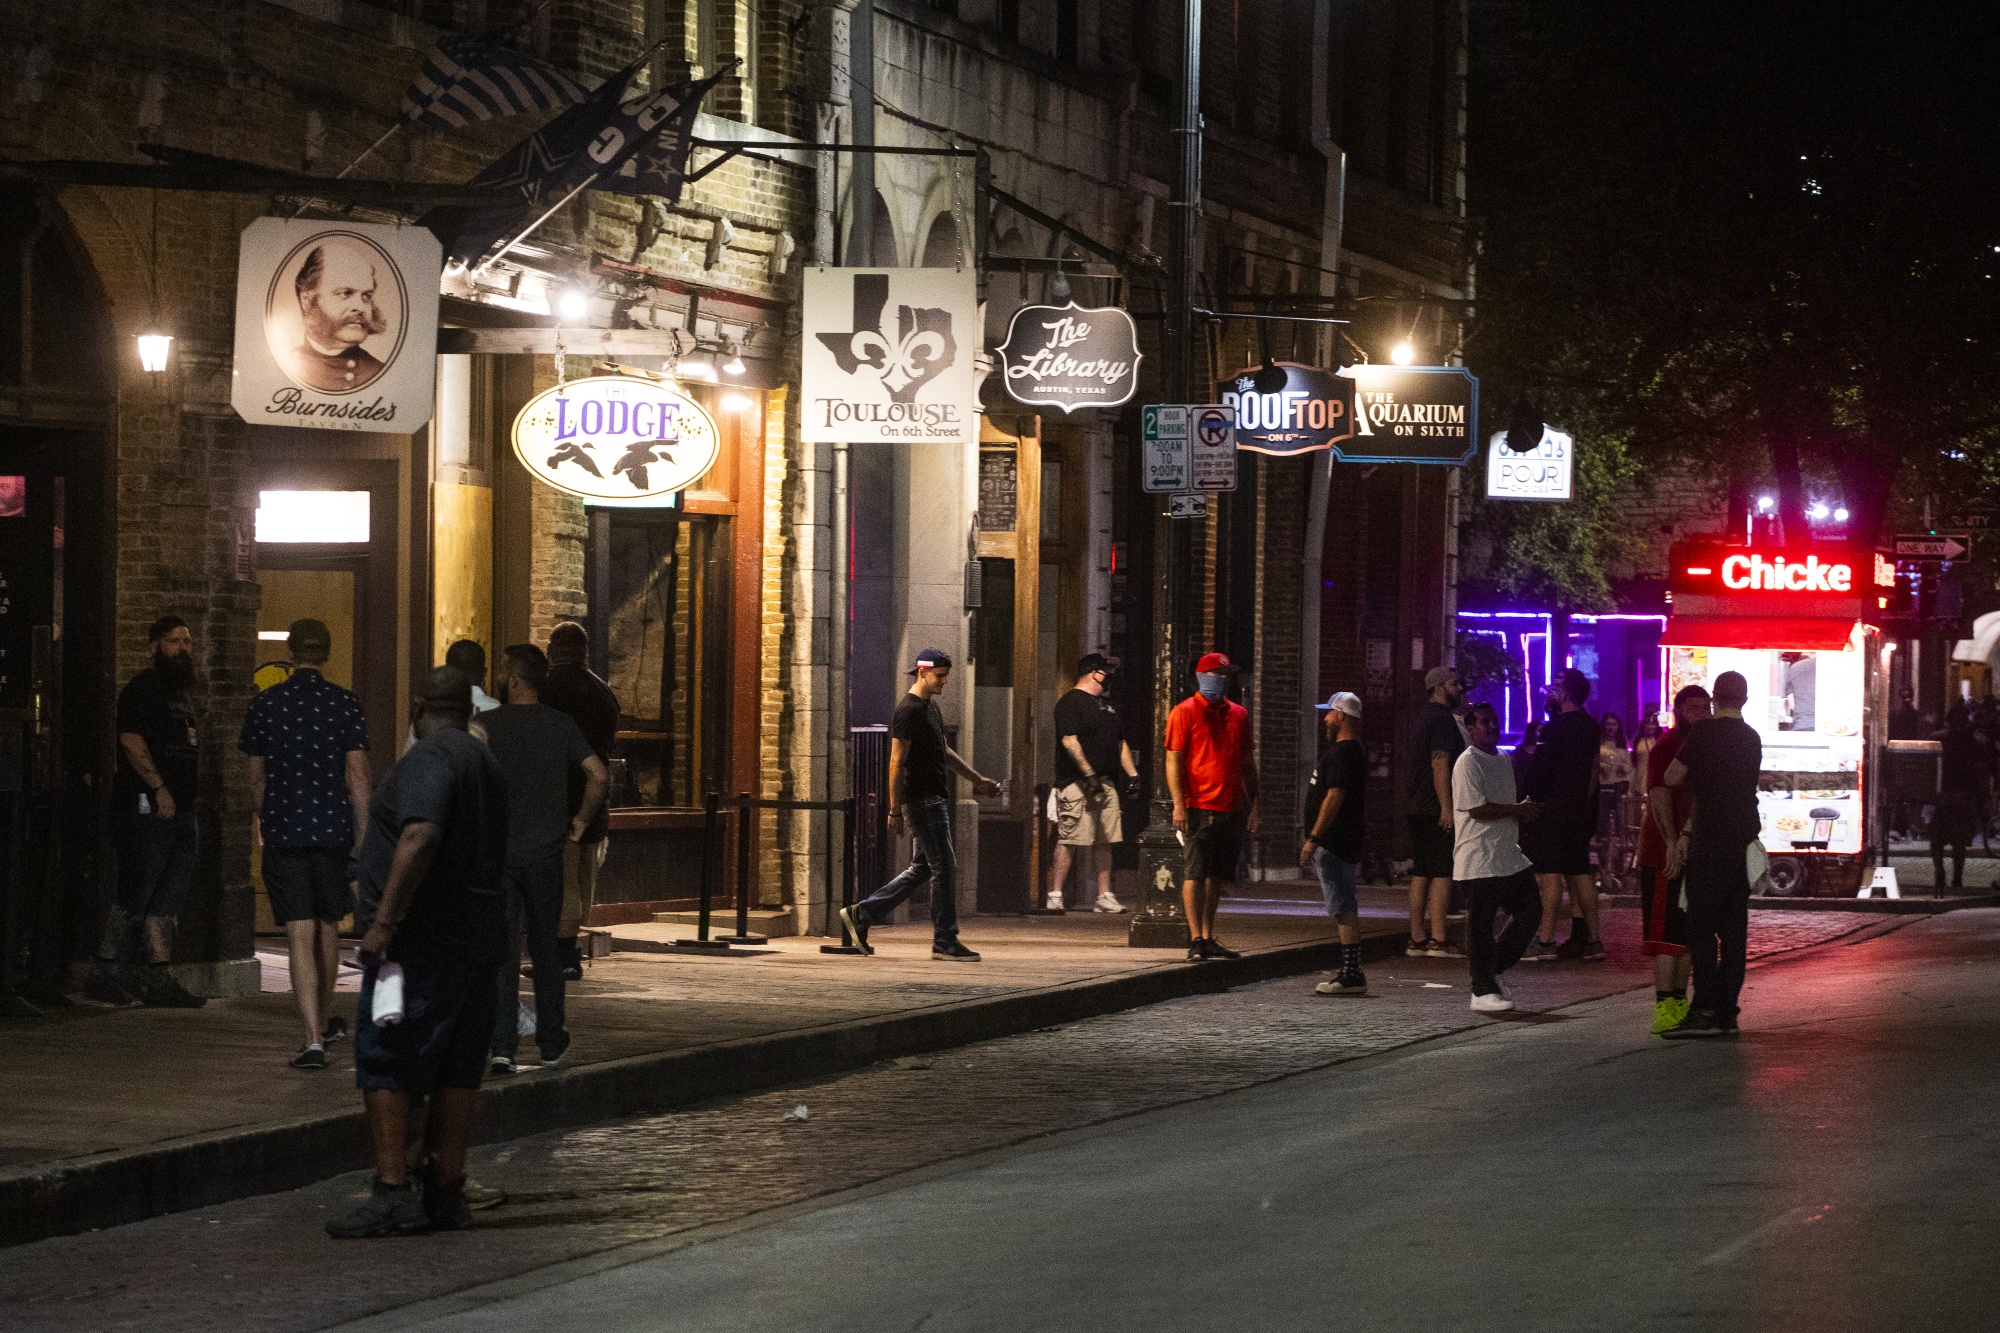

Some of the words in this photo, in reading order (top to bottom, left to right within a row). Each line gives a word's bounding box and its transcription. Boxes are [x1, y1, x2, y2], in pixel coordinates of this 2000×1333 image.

[1042, 316, 1092, 349] The
[1008, 348, 1130, 385] Library
[1033, 385, 1073, 395] AUSTIN,
[1074, 386, 1107, 395] TEXAS
[1366, 392, 1395, 404] THE
[554, 398, 681, 442] LODGE
[815, 398, 961, 427] TOULOUSE
[1355, 392, 1465, 436] AQUARIUM
[881, 425, 899, 437] On
[903, 425, 922, 437] 6th
[926, 425, 961, 437] Street
[1145, 412, 1157, 435] 2
[1394, 425, 1414, 436] ON
[1421, 425, 1465, 437] SIXTH
[1267, 433, 1284, 442] ON
[1161, 453, 1173, 464] TO
[1502, 464, 1559, 484] POUR
[1722, 554, 1852, 591] Chicke
